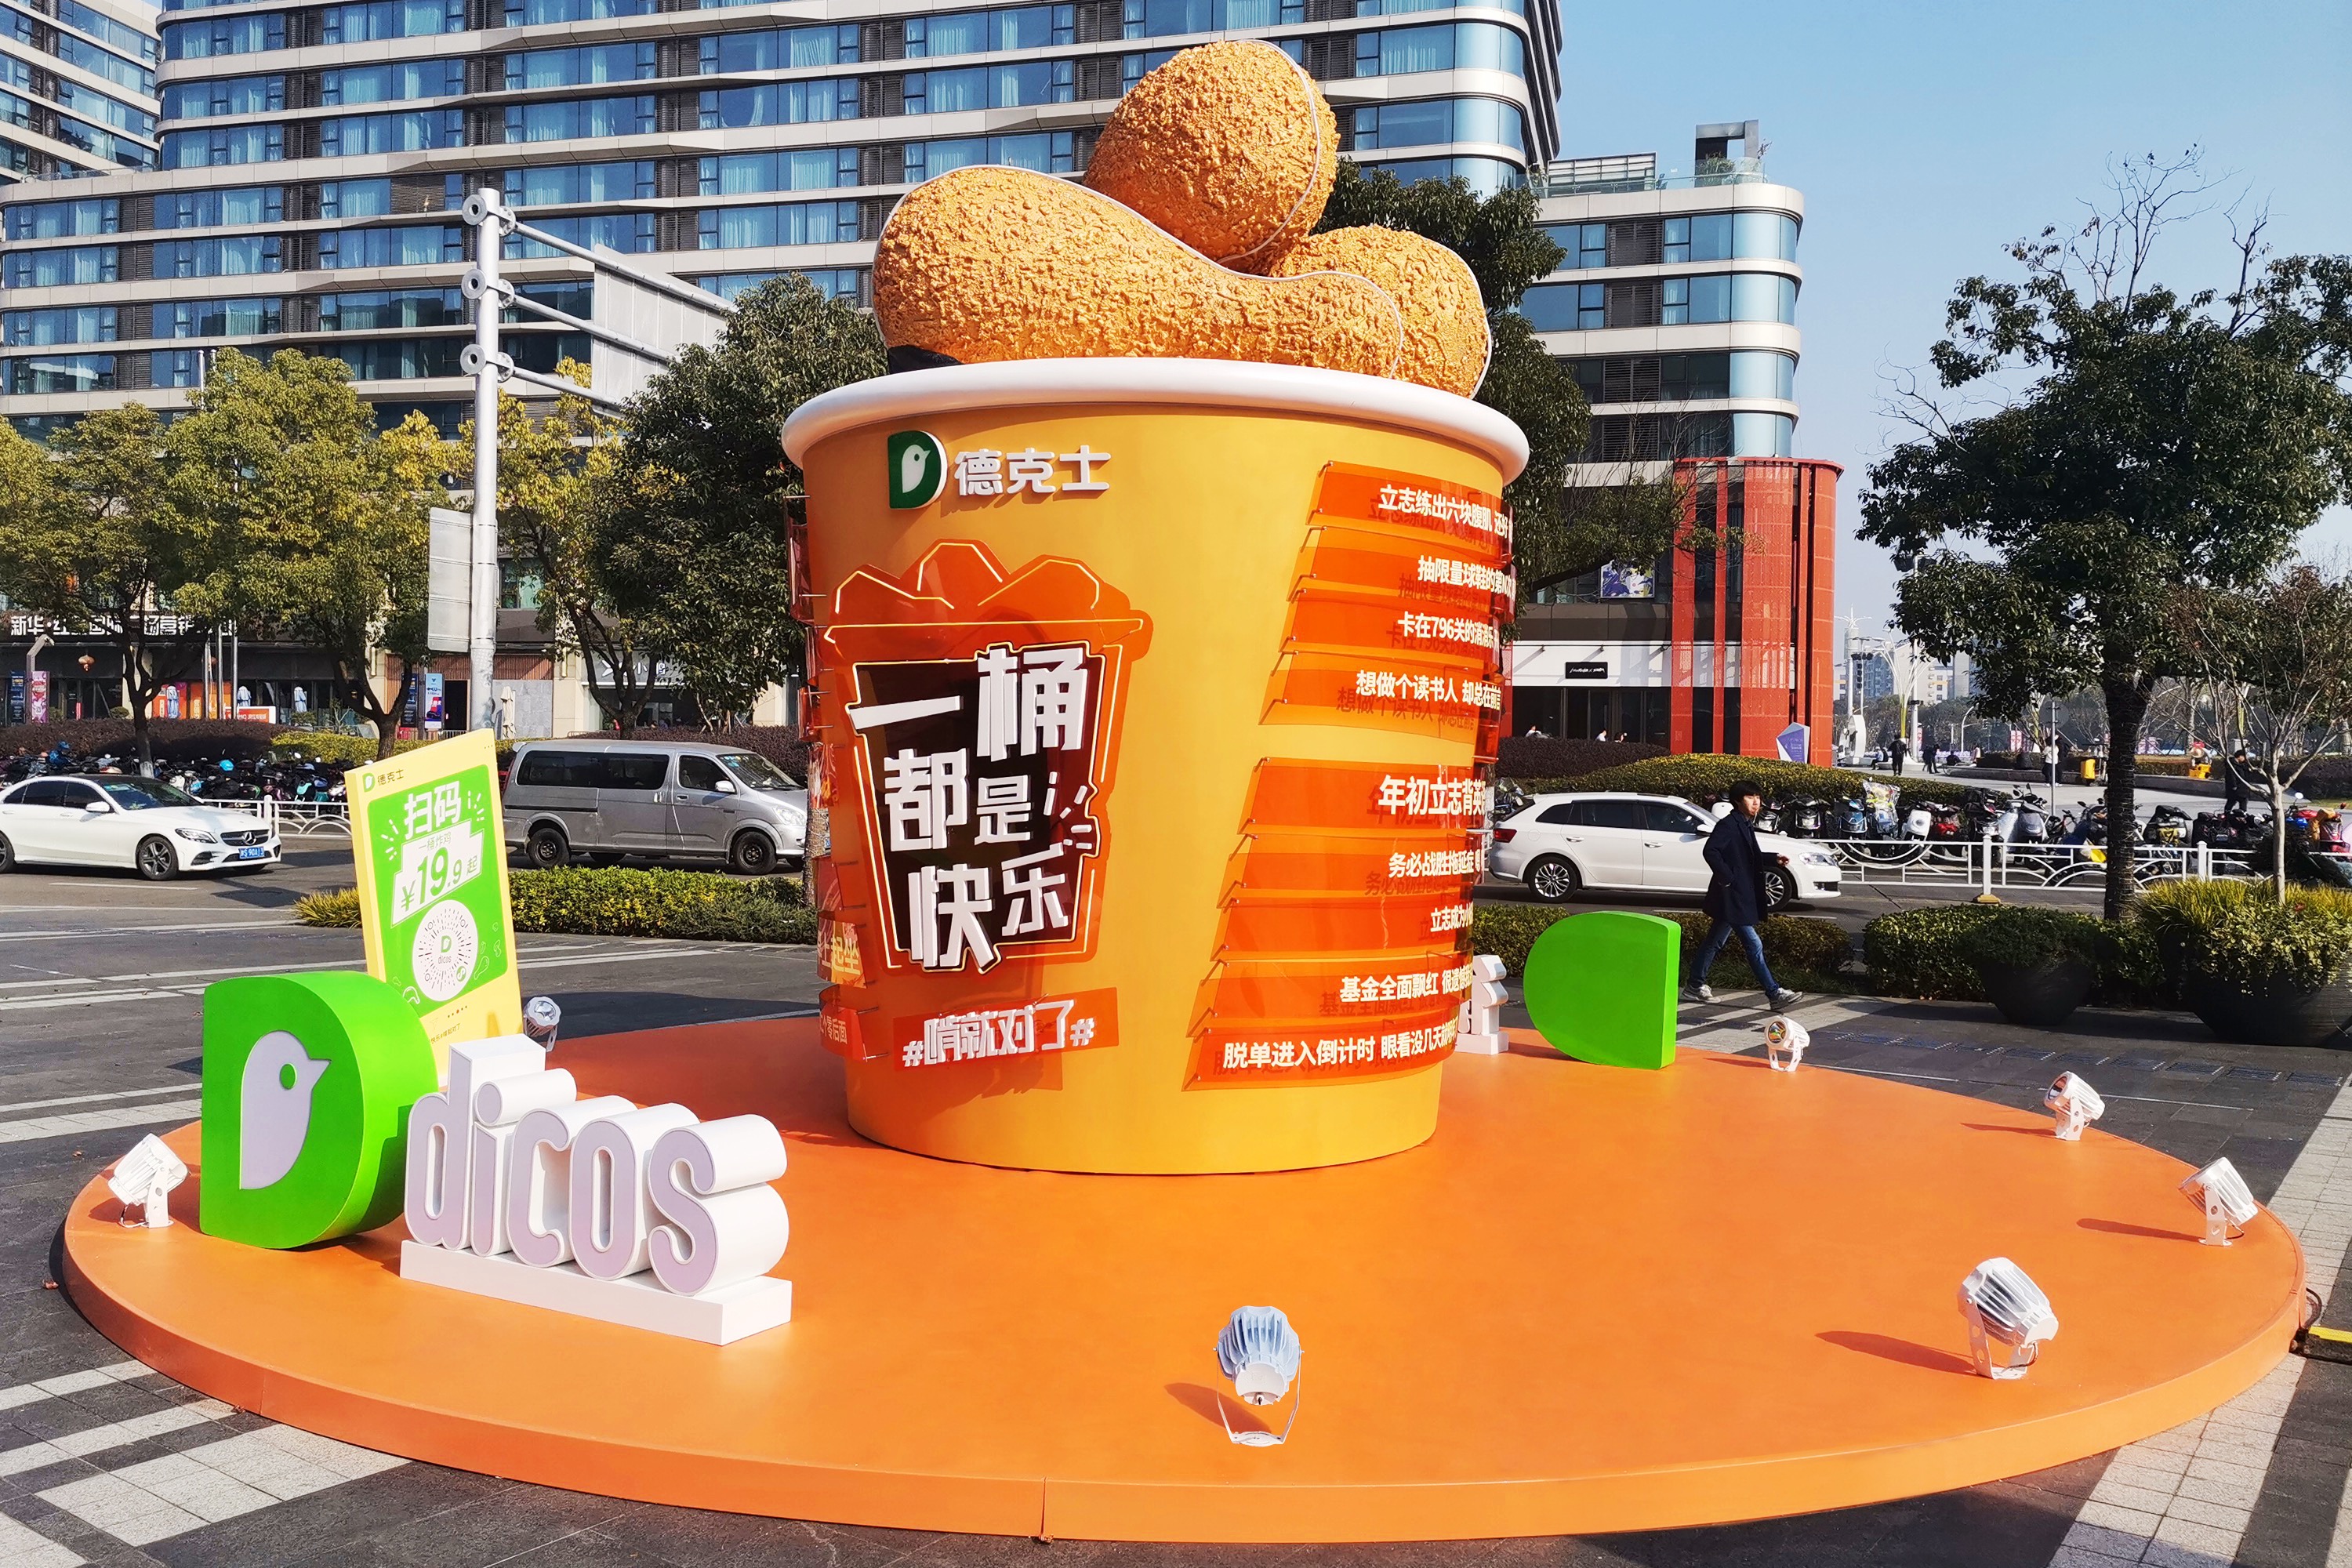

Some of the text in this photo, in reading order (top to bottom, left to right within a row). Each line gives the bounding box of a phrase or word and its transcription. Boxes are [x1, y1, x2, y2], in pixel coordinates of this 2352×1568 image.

[953, 445, 1111, 496] 德克士
[1378, 484, 1493, 532] 立志练出六块腹肌
[1417, 554, 1517, 602] 抽限量球鞋的第N次
[849, 648, 1088, 762] 一桶
[1356, 669, 1458, 704] 想做个读书人
[377, 768, 405, 786] 德克士
[884, 748, 1032, 851] 都是
[404, 781, 462, 840] 扫码
[418, 831, 452, 852] 一桶炸鸡
[1388, 849, 1474, 878] 务必战胜拖延症
[466, 855, 478, 877] 起
[907, 844, 1069, 967] 快乐
[1339, 971, 1439, 1004] 基金全面飘红
[1222, 1036, 1376, 1069] 脱单进入倒计时
[404, 1039, 737, 1296] dicos
